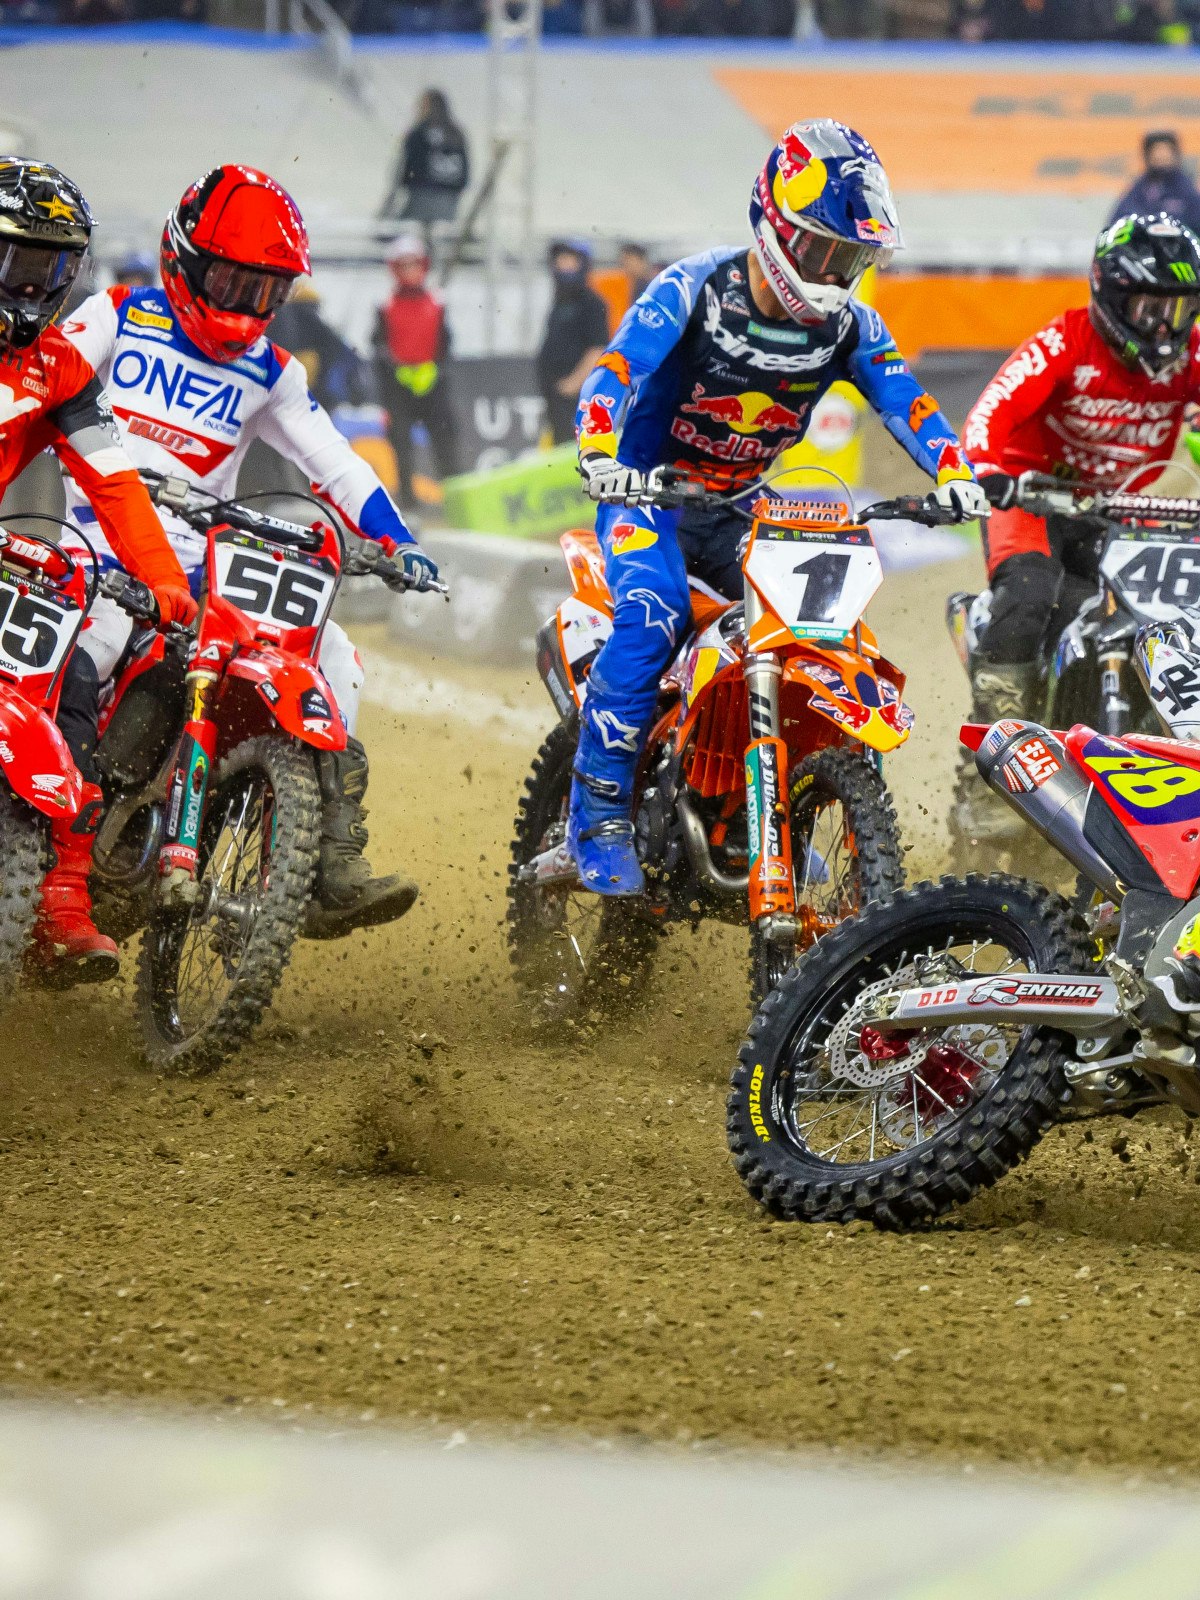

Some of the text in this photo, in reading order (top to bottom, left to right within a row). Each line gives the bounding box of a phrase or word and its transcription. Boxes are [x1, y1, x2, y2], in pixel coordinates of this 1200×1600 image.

[671, 418, 734, 460] Red
[767, 510, 842, 523] RENTHAL
[769, 500, 844, 512] RENTHAL
[222, 553, 326, 627] 56
[792, 550, 852, 622] 1
[746, 785, 761, 860] MOTOREX
[971, 977, 1102, 1005] RENTHAL
[749, 1063, 770, 1138] DUNLOP
